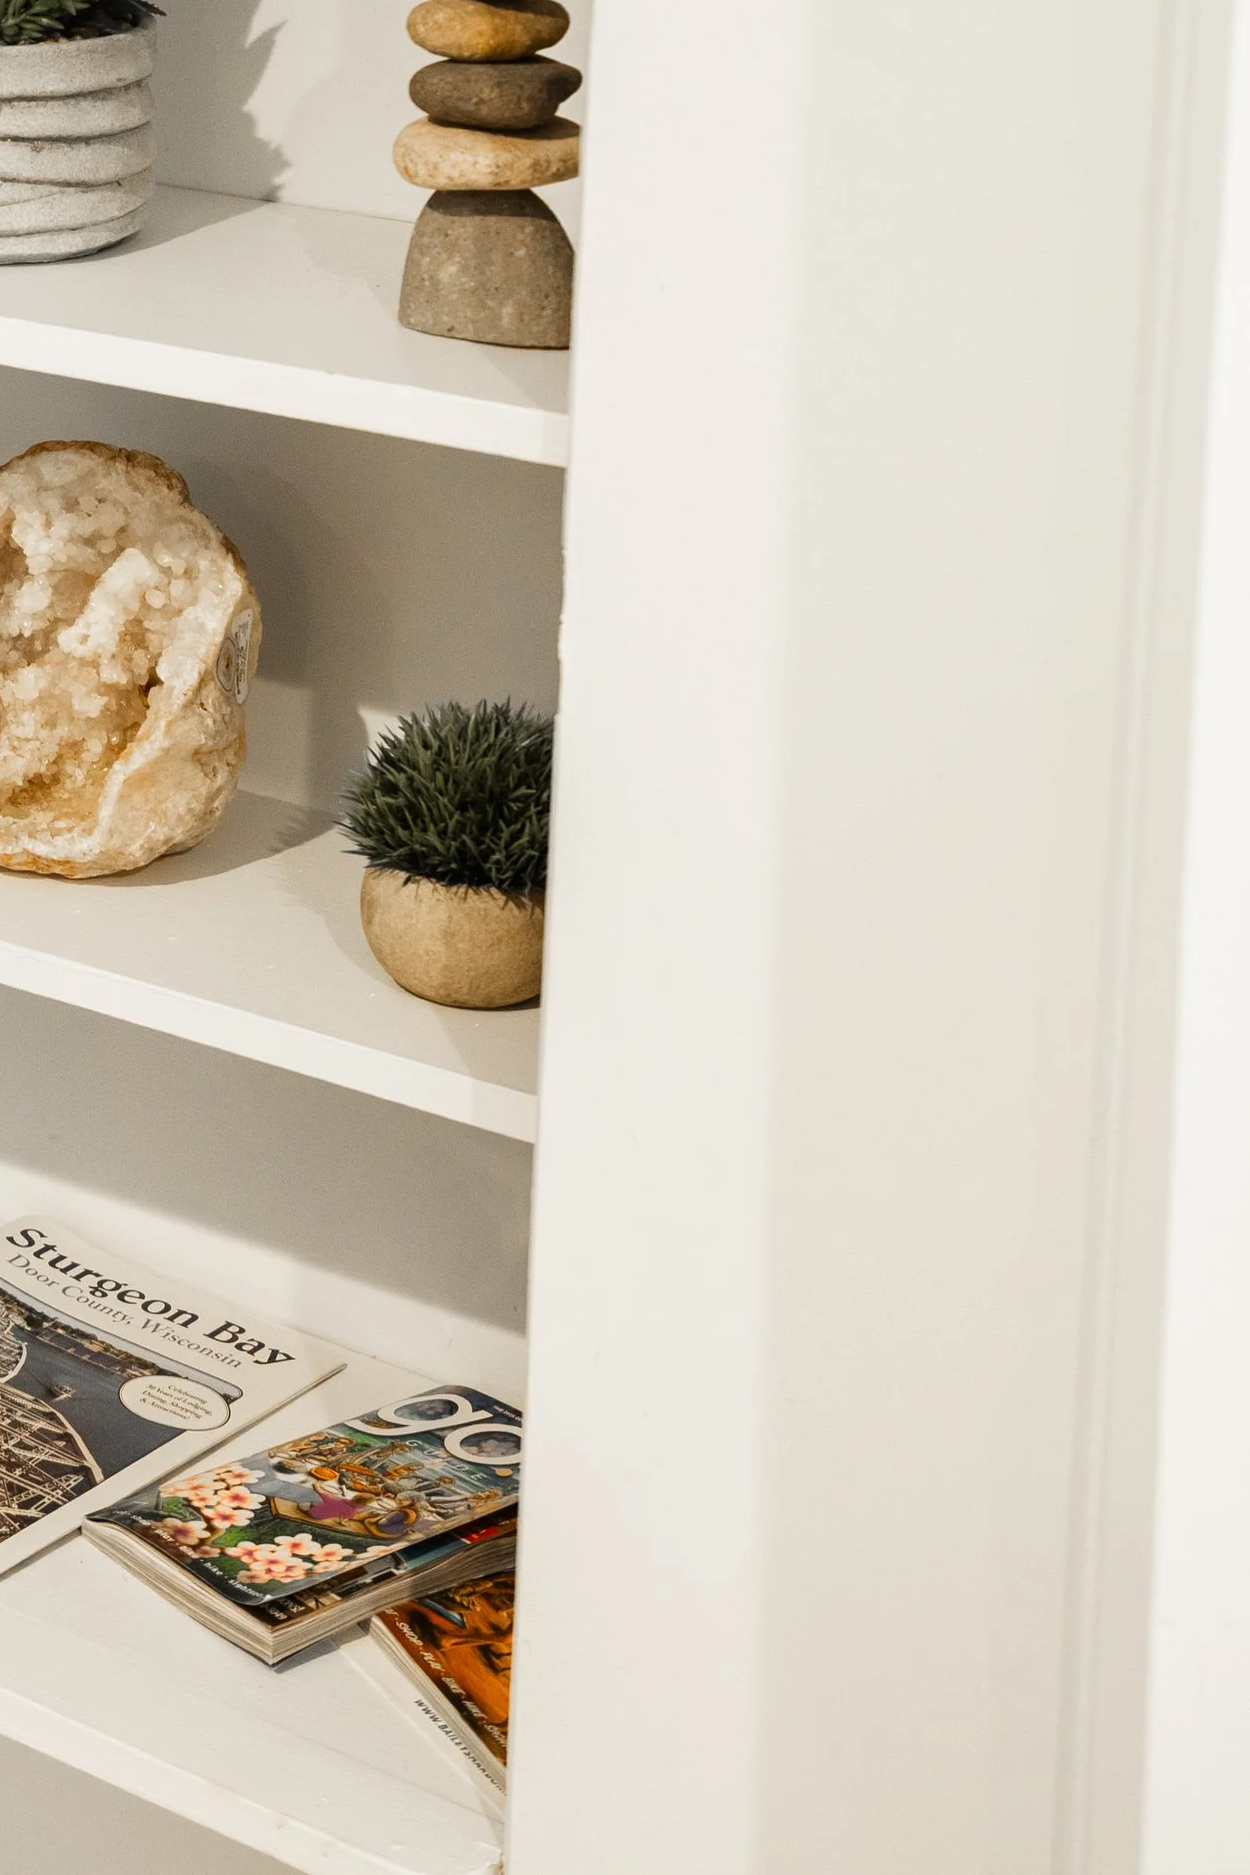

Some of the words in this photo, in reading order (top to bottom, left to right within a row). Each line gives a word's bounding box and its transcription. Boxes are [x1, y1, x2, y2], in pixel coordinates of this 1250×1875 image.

[5, 1227, 200, 1329] Sturgeon
[202, 1319, 297, 1366] Bay
[5, 1253, 61, 1289] Door
[61, 1284, 133, 1326] County,
[140, 1317, 243, 1369] Wisconsin
[154, 1527, 176, 1543] play
[202, 1560, 225, 1577] hike
[395, 1620, 425, 1648] SHOP
[419, 1649, 446, 1673] PLAY
